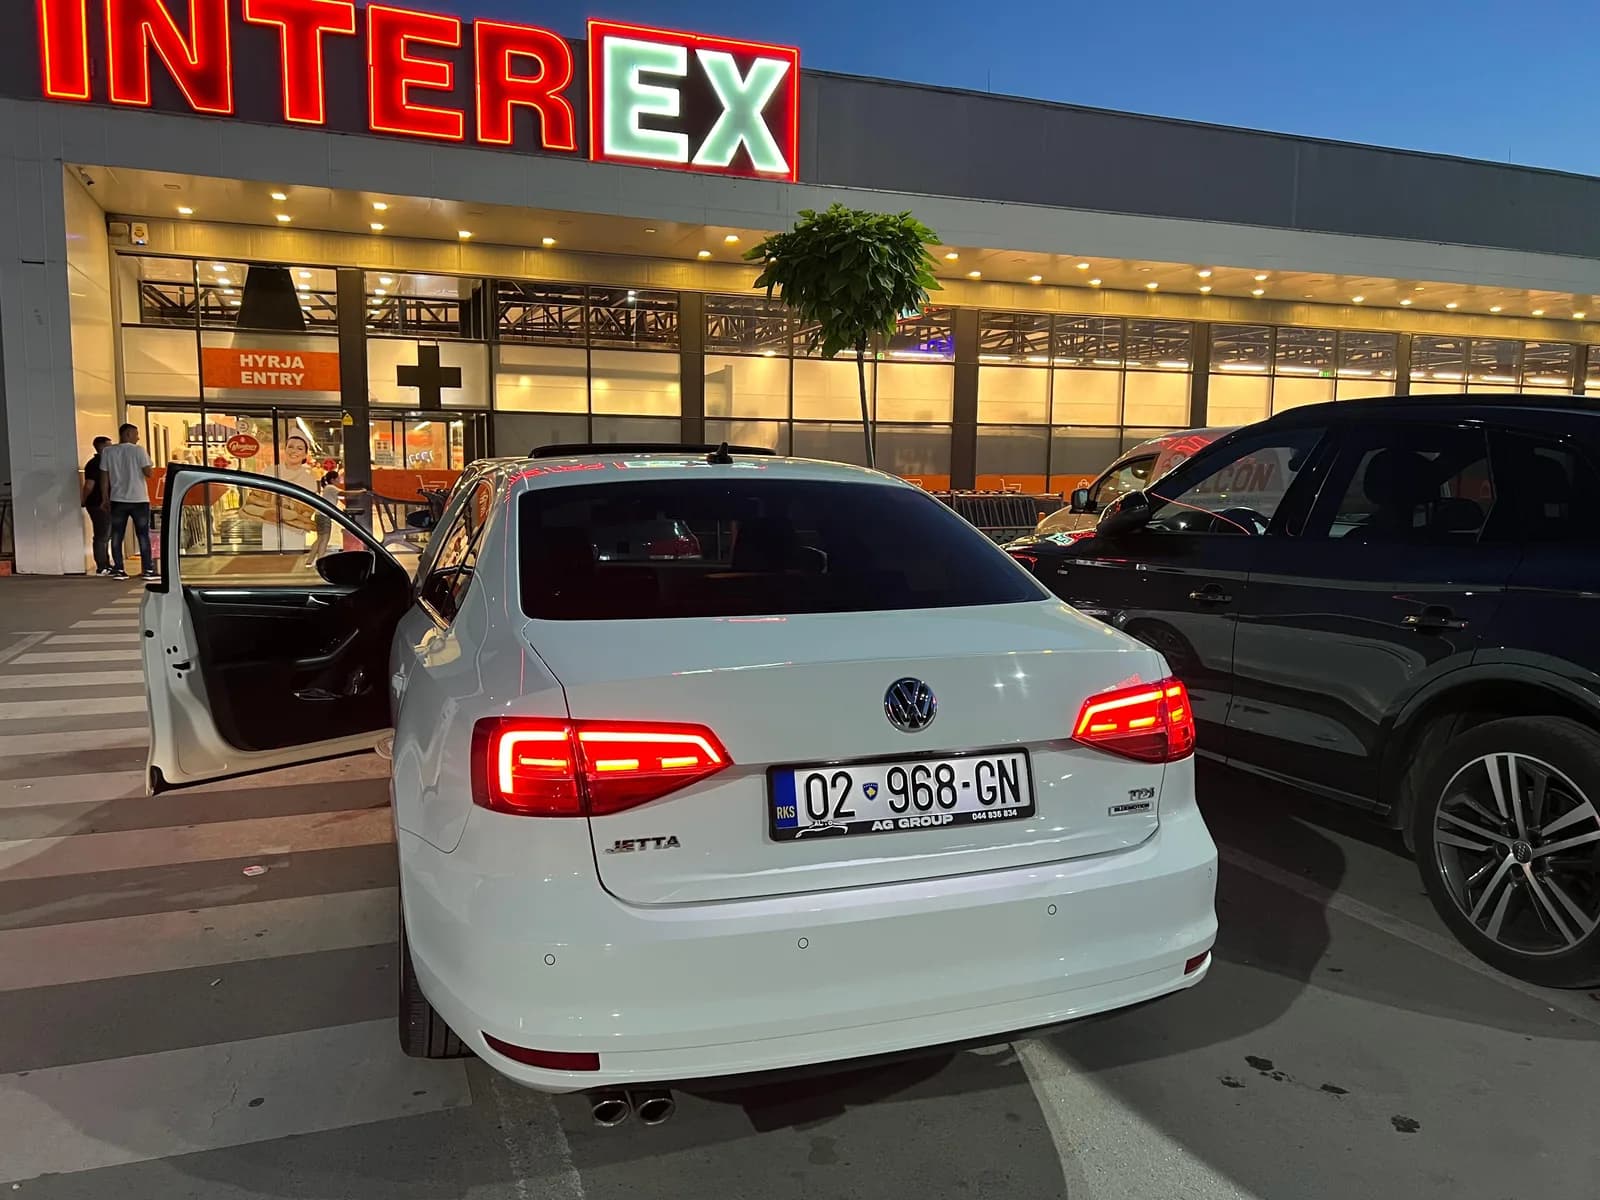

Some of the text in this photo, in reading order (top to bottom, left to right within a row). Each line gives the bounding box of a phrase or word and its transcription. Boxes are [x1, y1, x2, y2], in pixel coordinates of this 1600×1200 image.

[239, 353, 305, 370] HYRJA
[241, 371, 305, 386] ENTRY
[805, 758, 1021, 820] 02 968-GN
[776, 805, 796, 819] RKS
[872, 814, 954, 831] AG GROUP
[605, 835, 681, 854] JETTA
